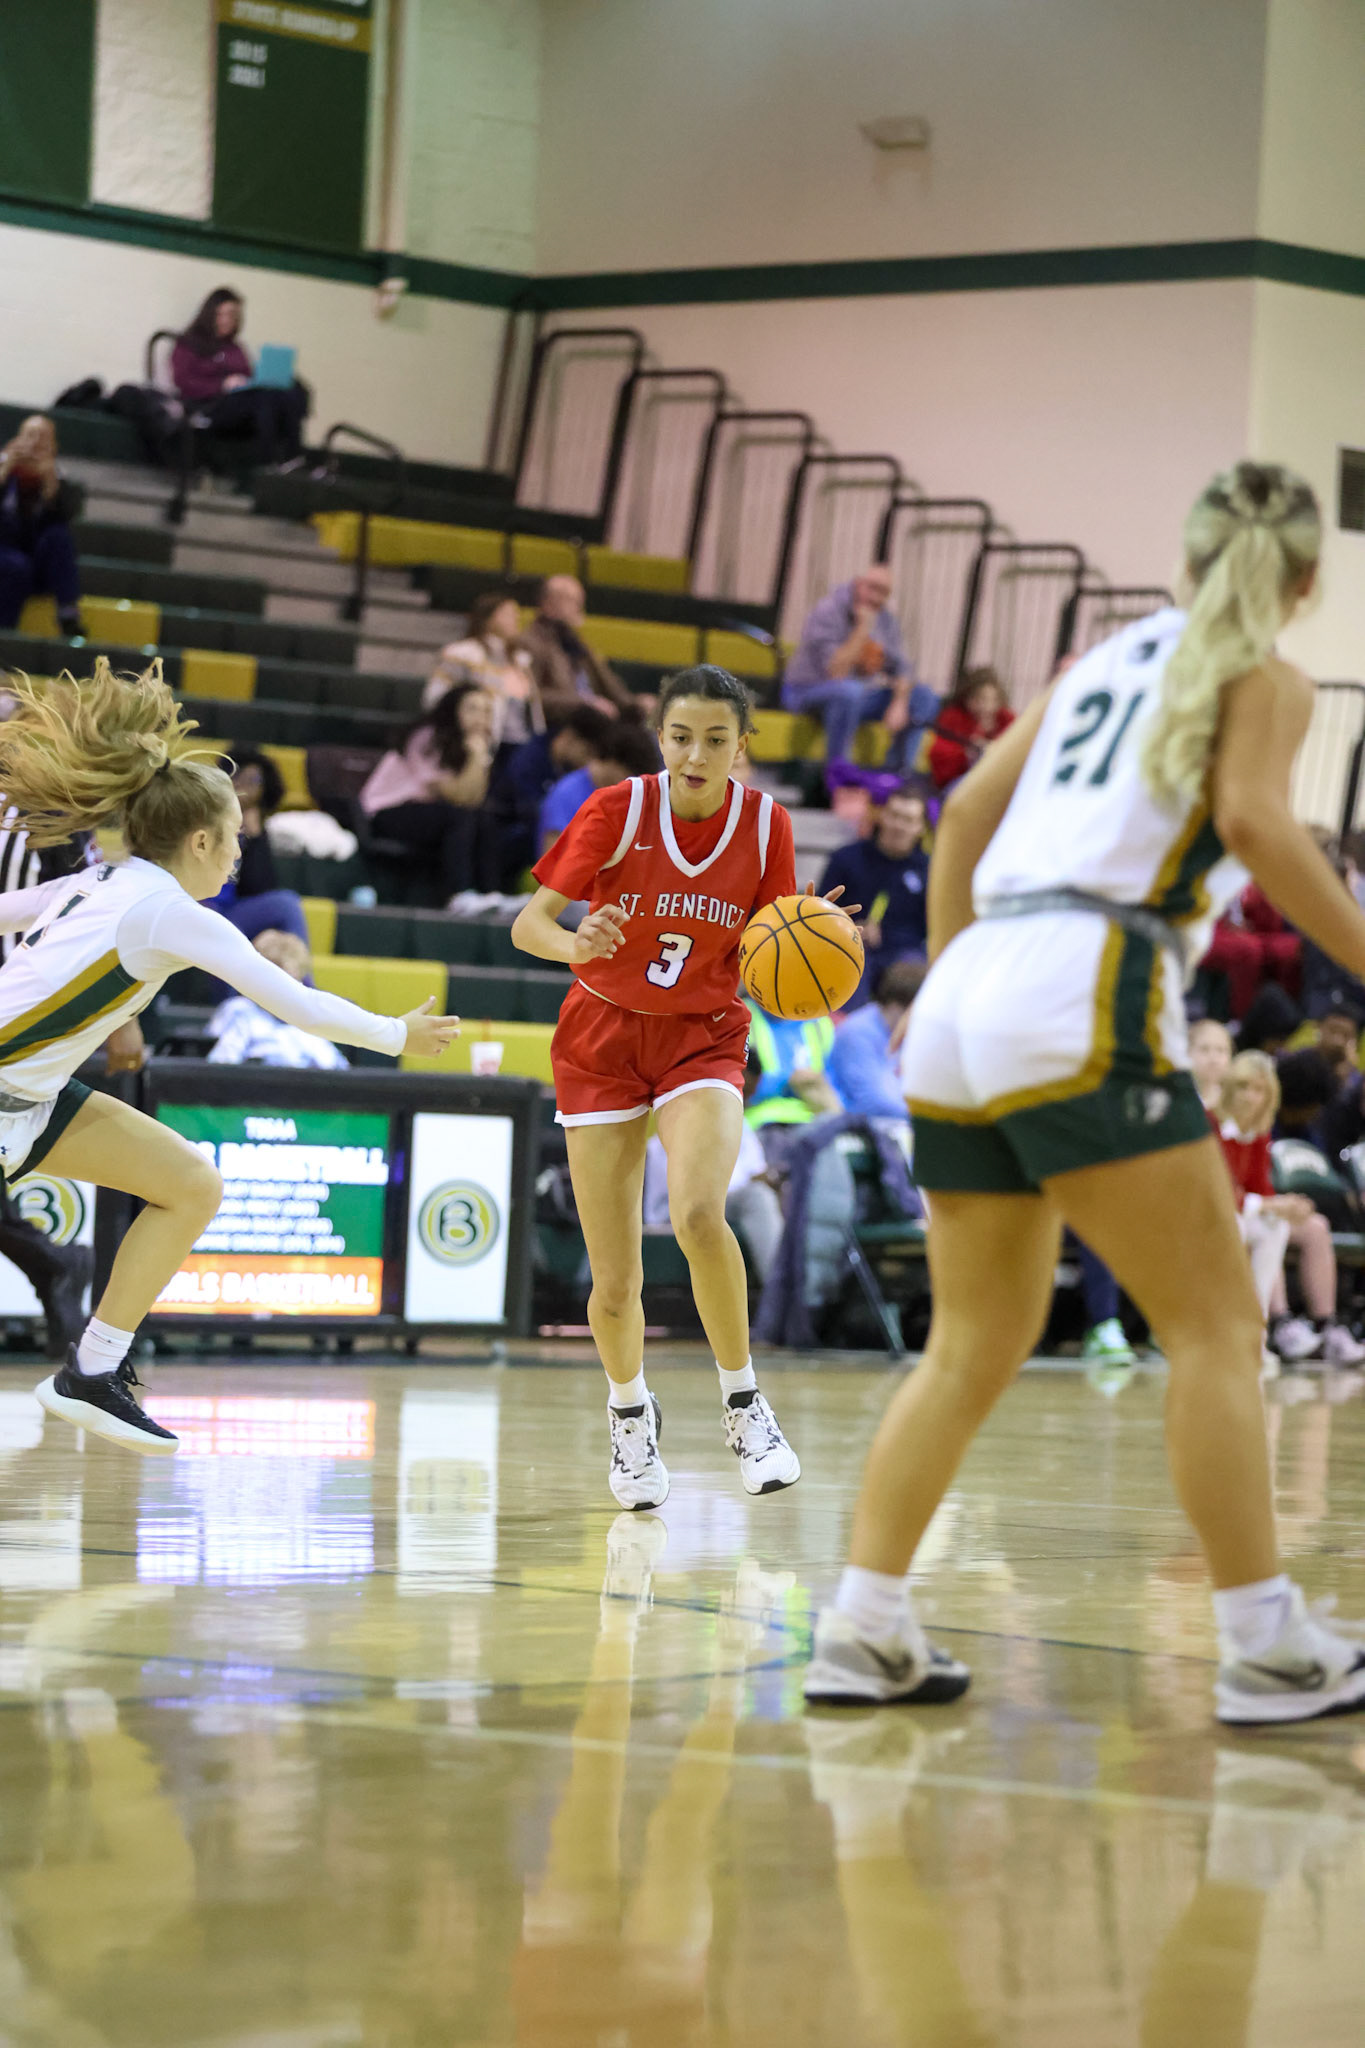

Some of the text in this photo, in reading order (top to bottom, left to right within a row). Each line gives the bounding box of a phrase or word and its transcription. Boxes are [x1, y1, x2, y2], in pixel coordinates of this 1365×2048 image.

[1054, 689, 1145, 786] 21
[619, 893, 745, 929] ST. BENEDICT
[645, 932, 695, 990] 3
[438, 1199, 478, 1248] B
[221, 1272, 375, 1305] BASKETBALL
